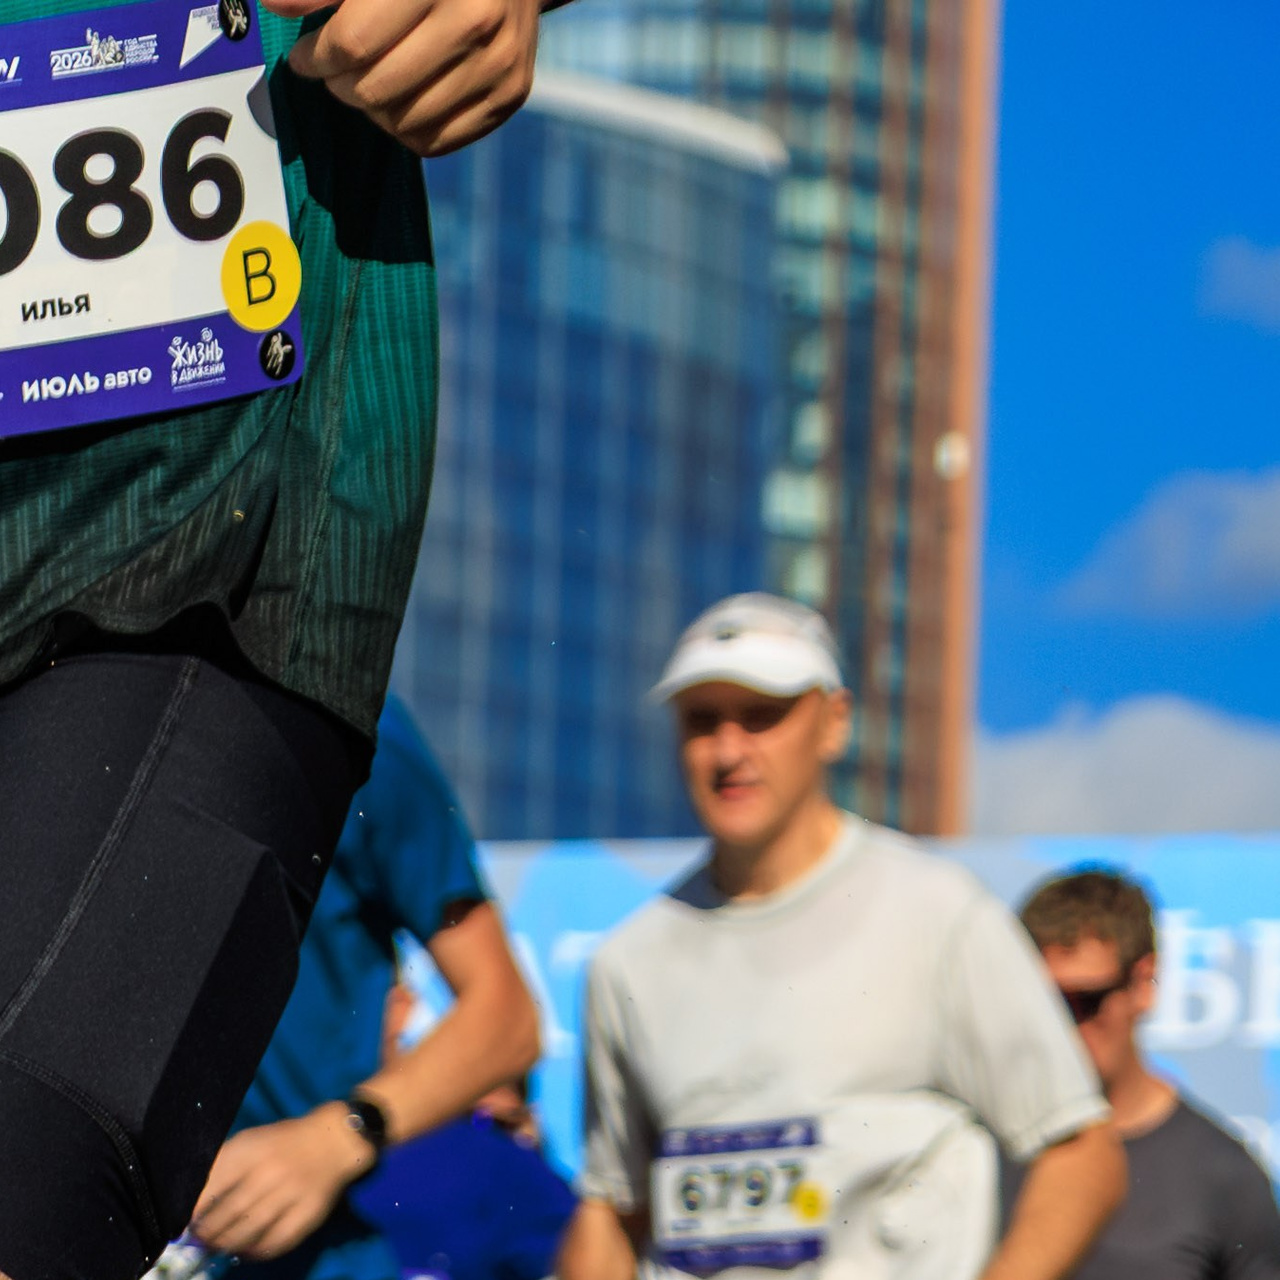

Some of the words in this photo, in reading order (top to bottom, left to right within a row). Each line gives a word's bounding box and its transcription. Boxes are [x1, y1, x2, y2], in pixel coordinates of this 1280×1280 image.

[51, 51, 92, 72] 2026
[21, 293, 91, 322] ИЛЬЯ
[168, 338, 224, 370] ЖИЗНЬ
[22, 371, 100, 403] ИЮЛЬ
[103, 366, 152, 390] авто
